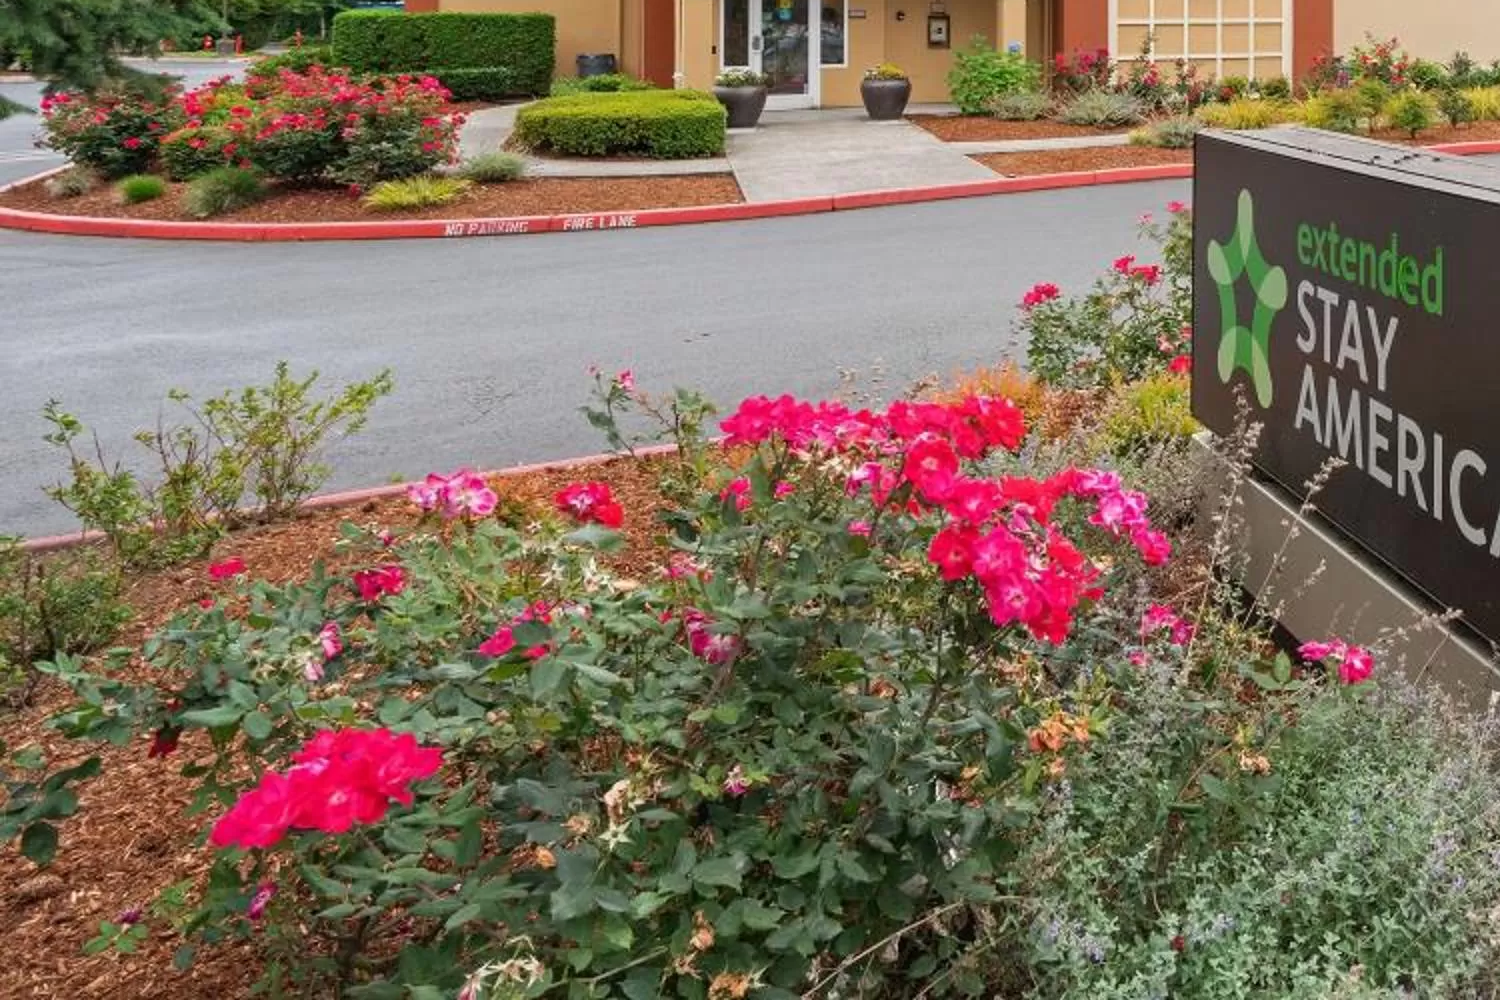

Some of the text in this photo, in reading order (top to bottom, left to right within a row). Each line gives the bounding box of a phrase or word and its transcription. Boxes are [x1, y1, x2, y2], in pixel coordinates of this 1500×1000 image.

[444, 221, 528, 236] NO PARKING
[563, 215, 637, 230] FIRE LANE
[1297, 220, 1443, 316] extended
[1296, 279, 1398, 391] STAY
